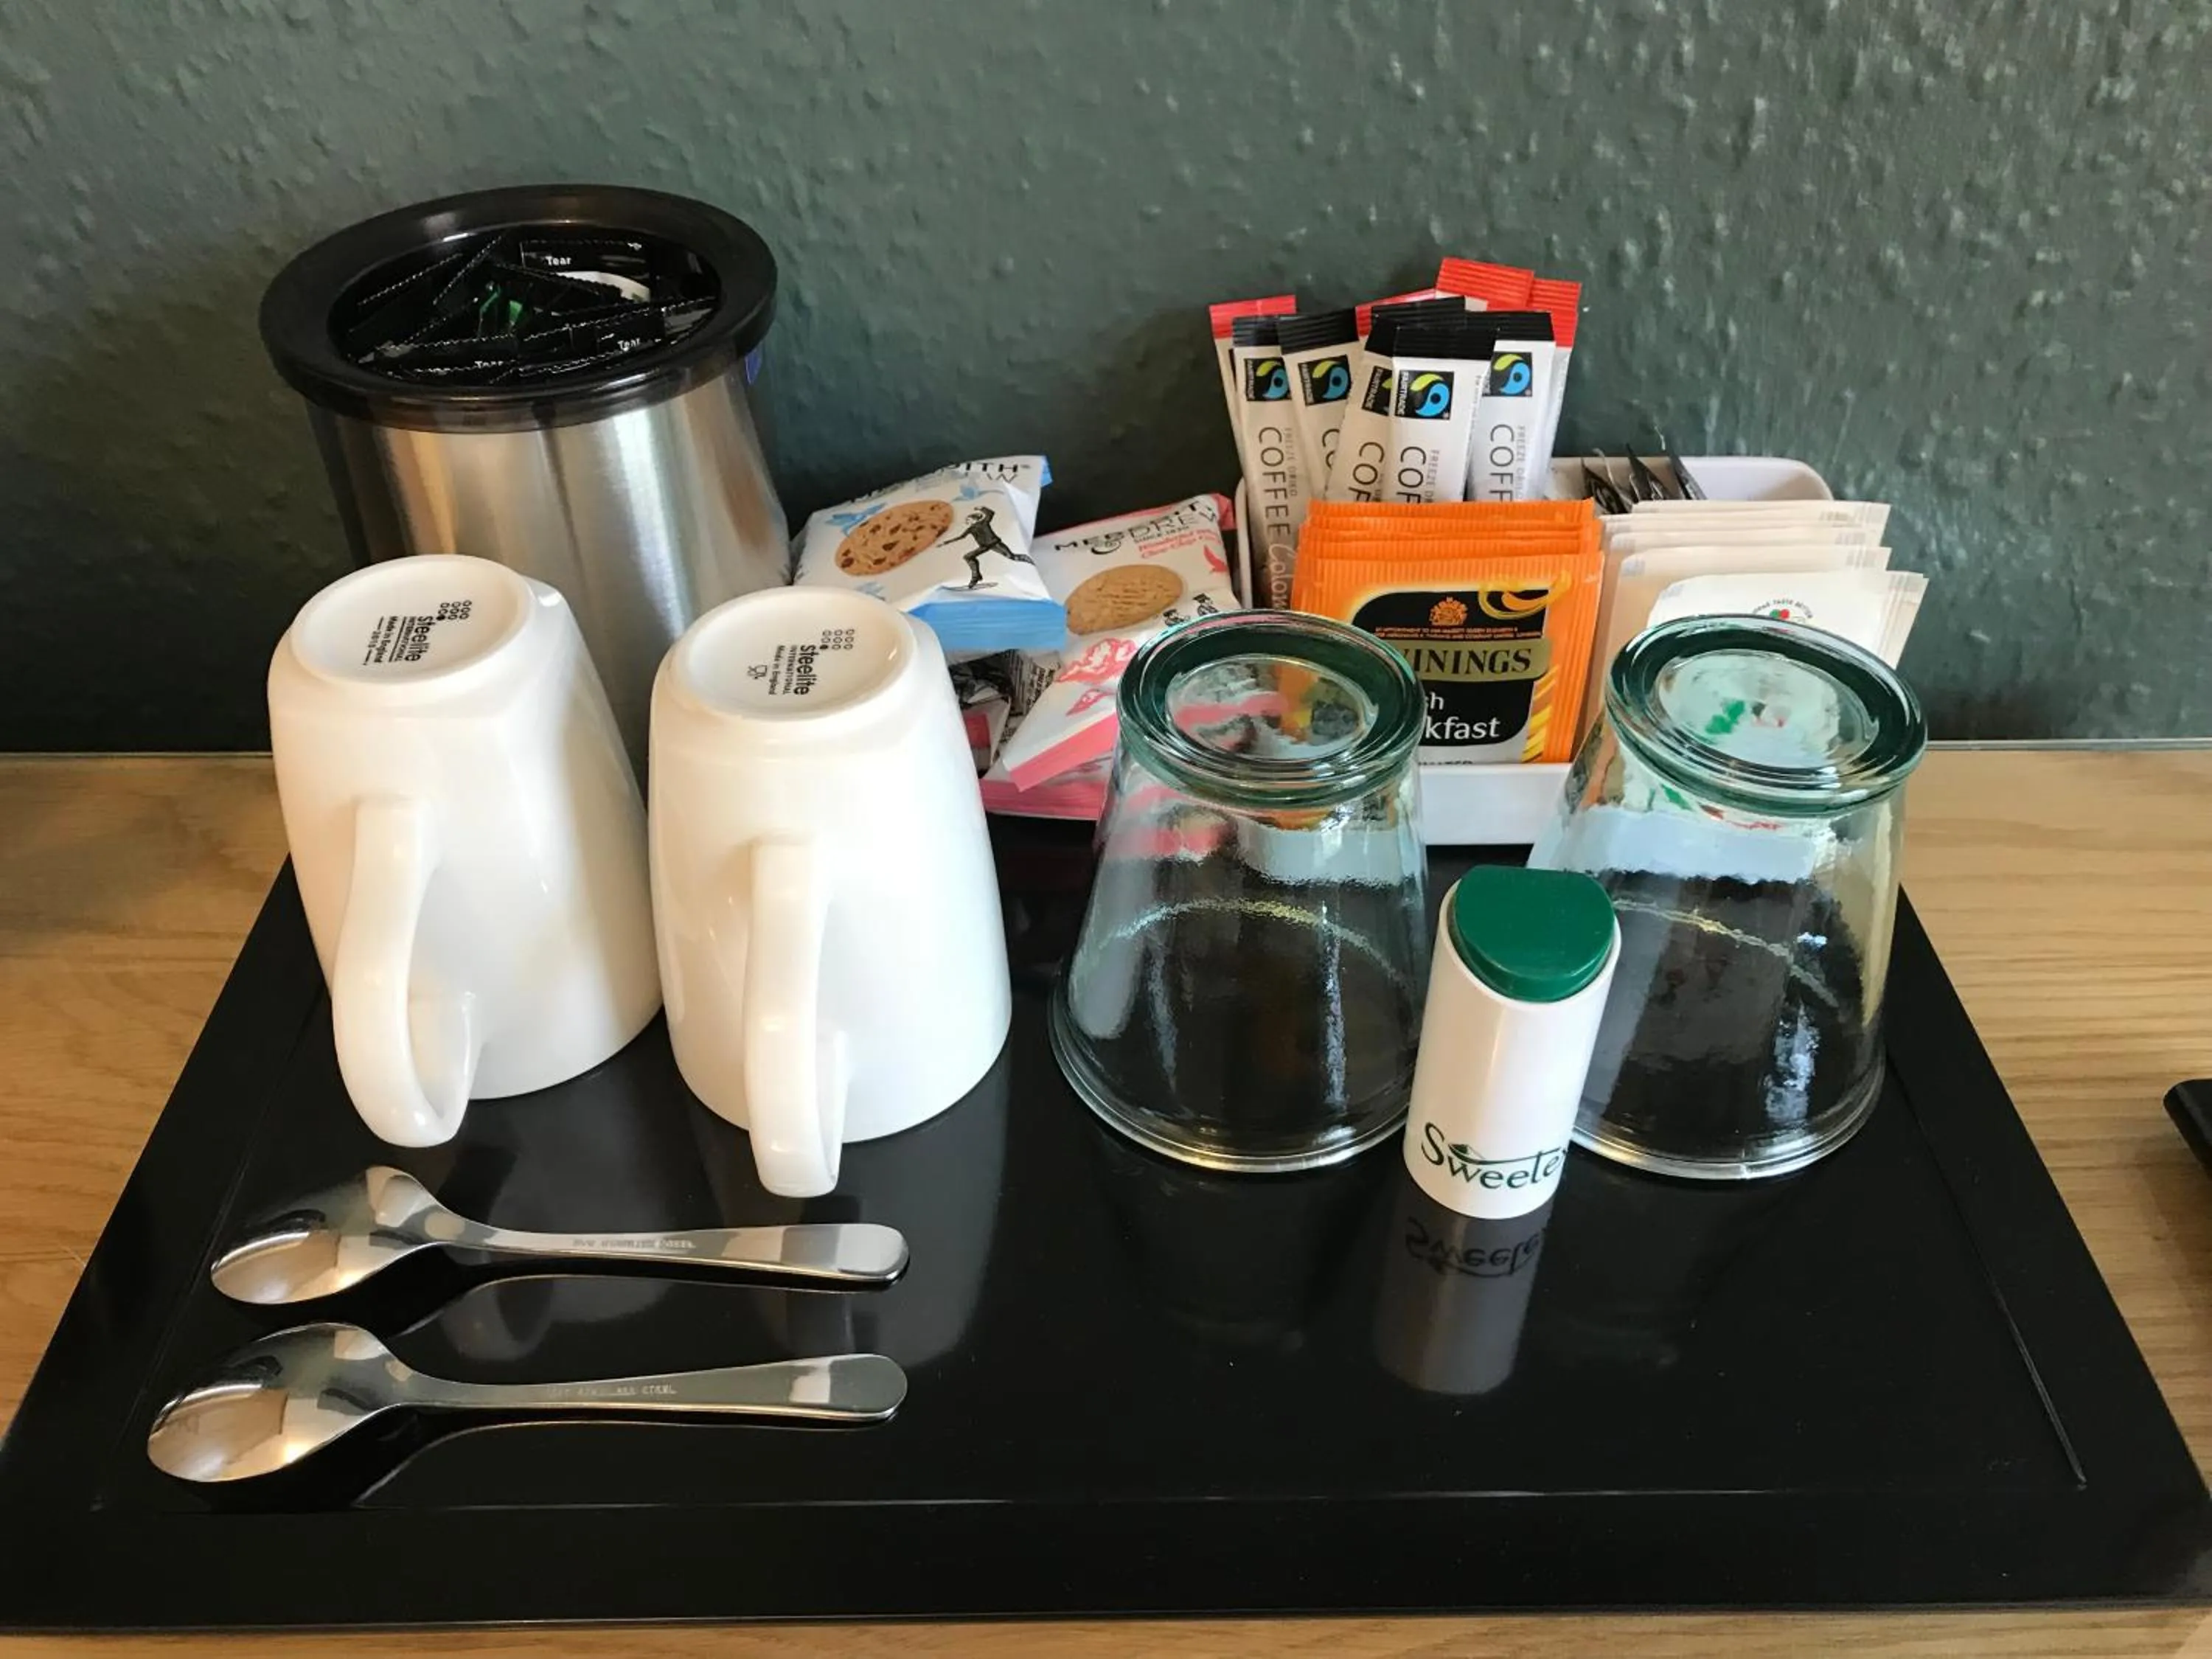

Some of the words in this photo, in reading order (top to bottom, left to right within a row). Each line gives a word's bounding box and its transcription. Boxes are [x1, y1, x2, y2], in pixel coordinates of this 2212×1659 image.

[545, 256, 571, 265] Tear
[617, 338, 640, 351] Tear
[1397, 371, 1409, 415] FAIRTRADE
[1258, 426, 1290, 536] COFFEE
[1348, 442, 1385, 503] COF
[1397, 446, 1427, 504] COF
[1488, 424, 1514, 502] COFF
[404, 615, 437, 662] steelite
[782, 644, 799, 695] INTERNATIONAL
[793, 644, 820, 695] steelite
[1425, 715, 1501, 740] kfast
